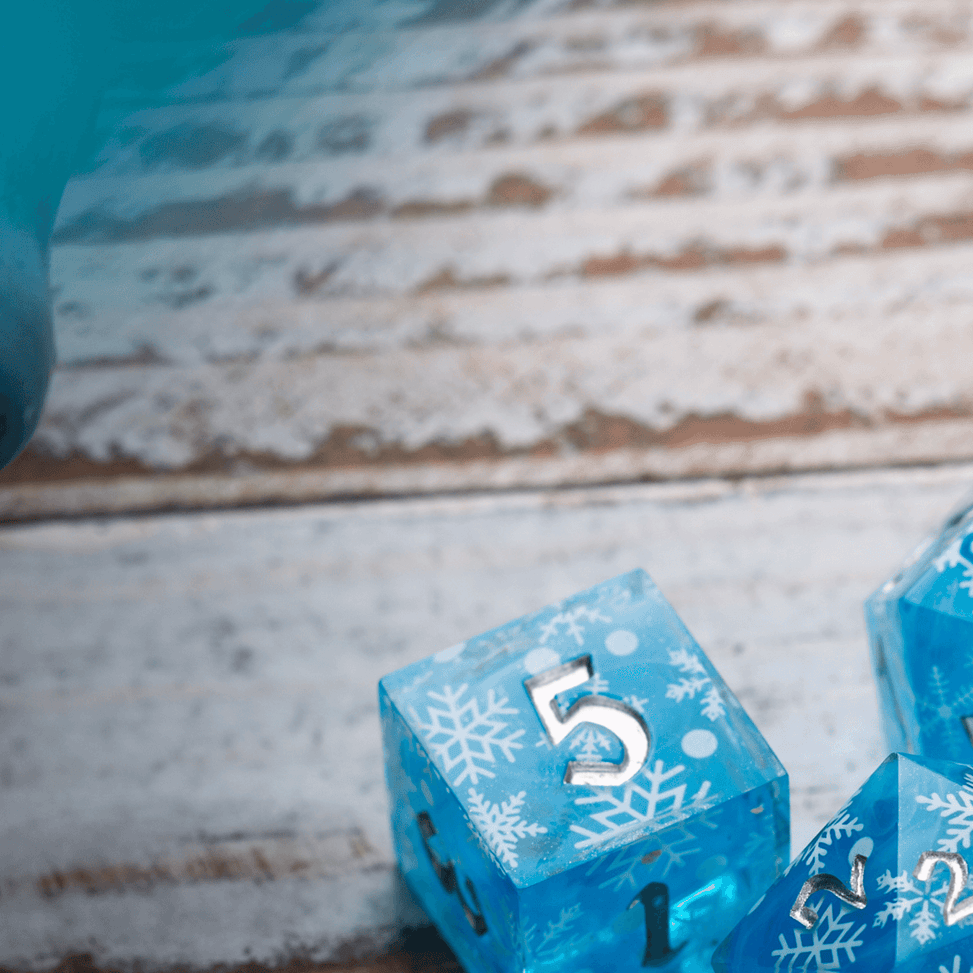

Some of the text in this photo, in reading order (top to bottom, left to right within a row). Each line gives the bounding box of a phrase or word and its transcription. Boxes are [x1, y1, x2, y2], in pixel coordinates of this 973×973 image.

[523, 654, 651, 787] 5
[626, 881, 686, 967] 1
[790, 854, 867, 929] 2
